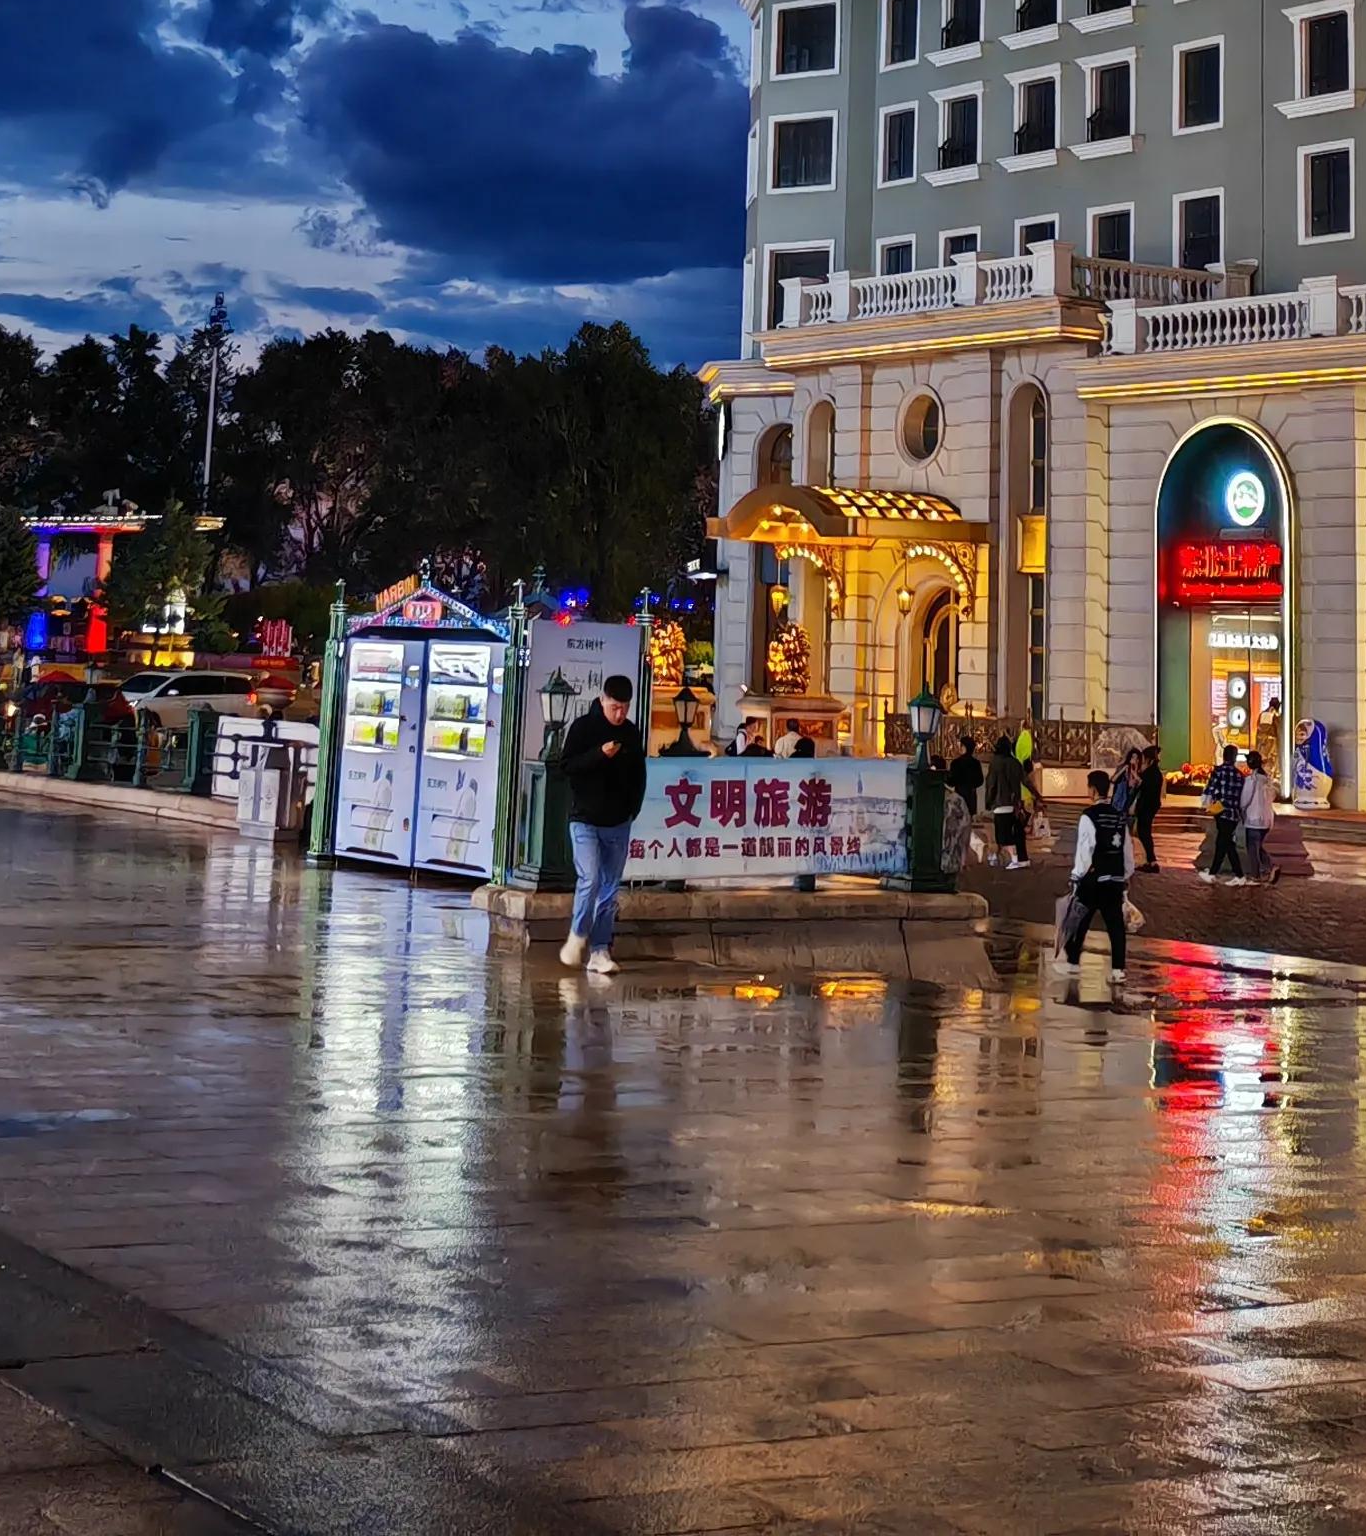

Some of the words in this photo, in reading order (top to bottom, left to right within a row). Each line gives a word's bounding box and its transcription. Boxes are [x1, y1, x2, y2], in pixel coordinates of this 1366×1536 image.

[375, 573, 419, 613] HARBIN
[664, 778, 833, 828] 文明旅游
[629, 836, 862, 860] 每个人都是一道靓丽的风景线
